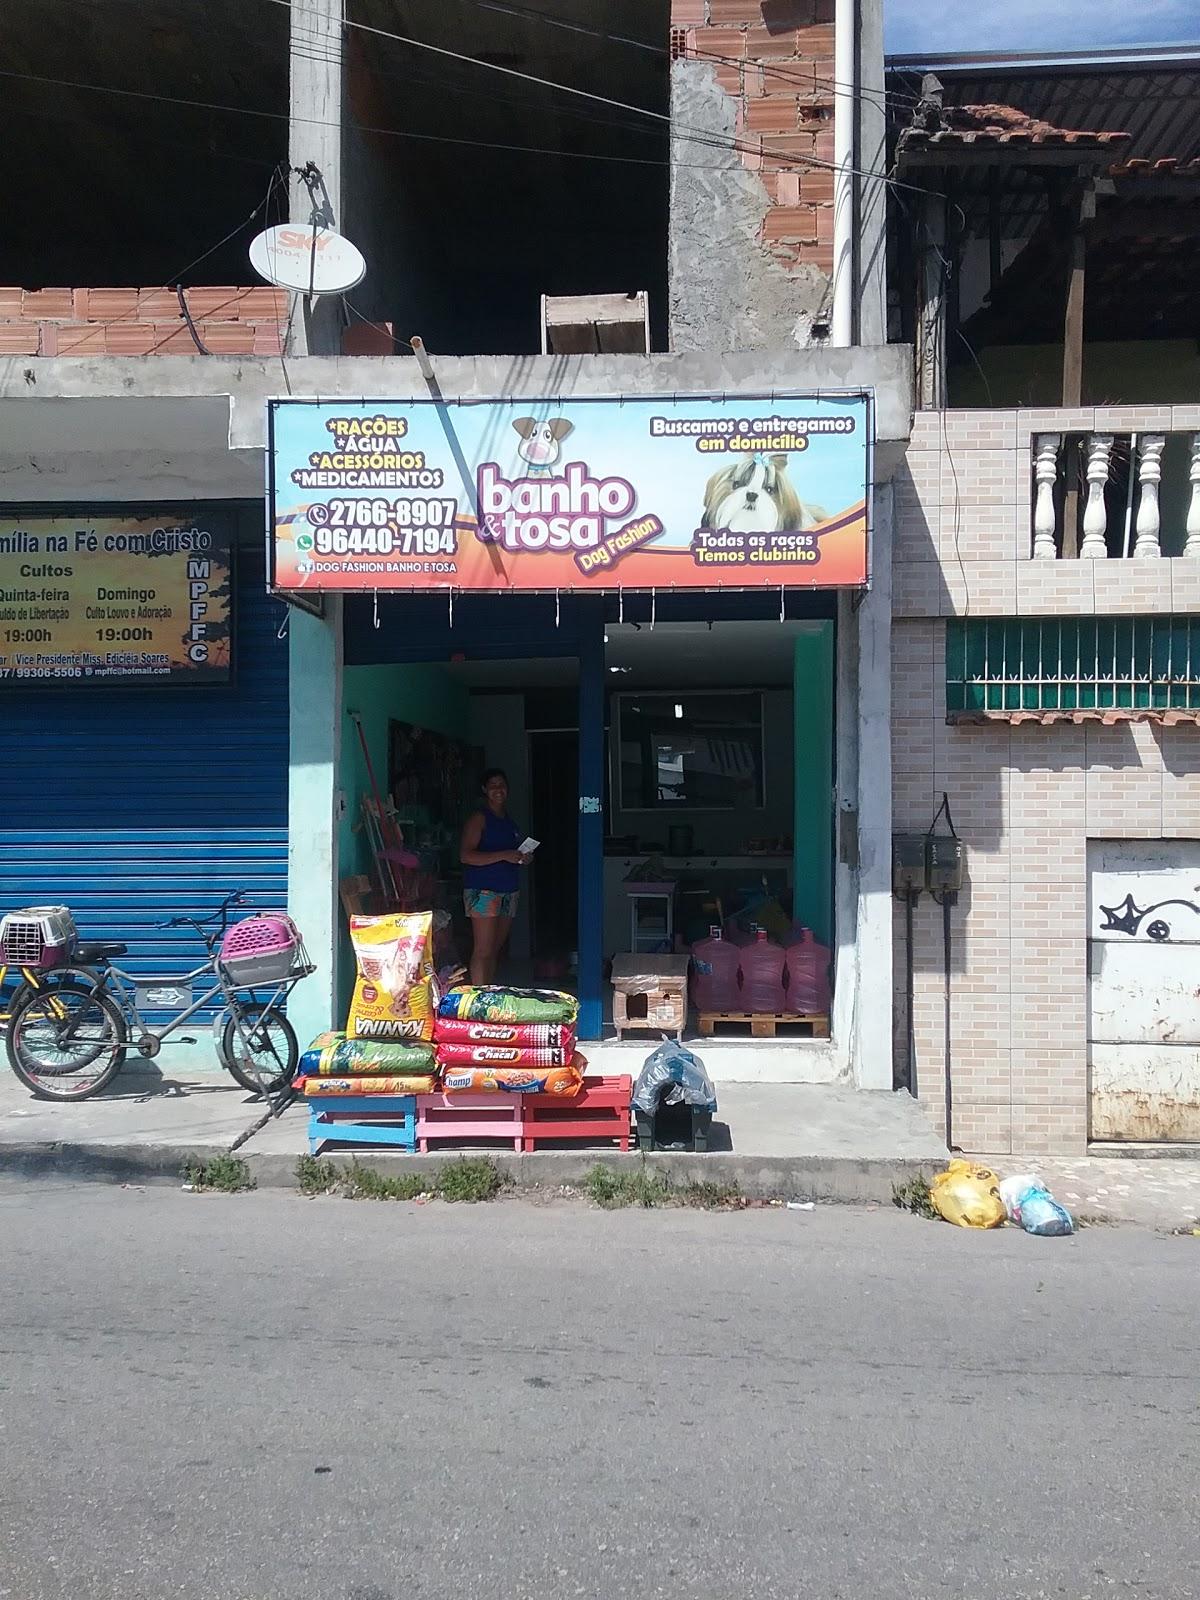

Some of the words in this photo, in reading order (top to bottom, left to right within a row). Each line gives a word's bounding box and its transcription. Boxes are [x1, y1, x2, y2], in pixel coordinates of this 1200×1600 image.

[652, 419, 734, 434] Buscamos
[739, 421, 749, 432] e
[753, 418, 852, 434] entregamos
[699, 438, 724, 450] em
[729, 434, 806, 449] domicílio
[482, 467, 629, 514] banho
[330, 501, 455, 526] 2766-8907
[481, 515, 501, 537] &
[502, 511, 599, 547] tosa
[45, 535, 68, 552] na
[75, 529, 98, 551] Fé
[104, 533, 145, 551] com
[150, 528, 211, 551] Cristo
[316, 528, 455, 553] 96440-7194
[579, 546, 611, 570] Dog
[607, 518, 657, 554] Fashion
[699, 533, 744, 547] Todas
[749, 536, 766, 547] as
[771, 535, 813, 550] raças
[696, 548, 745, 562] Temos
[750, 548, 816, 561] clubinho
[20, 564, 73, 577] Cultos
[316, 562, 340, 573] DOG
[342, 562, 384, 573] FASHION
[386, 562, 422, 573] BANHO
[424, 562, 430, 573] E
[431, 562, 457, 573] TOSA
[97, 588, 156, 603] Domingo
[18, 607, 28, 620] de
[4, 629, 52, 642] 19:00h
[96, 627, 153, 641] 19:00h
[16, 653, 34, 665] Vice
[36, 653, 80, 665] Presidente
[141, 652, 169, 663] Soares
[16, 667, 82, 678] 99306-5506
[355, 1016, 425, 1038] KANINA
[469, 1024, 512, 1039] Chacal
[473, 1047, 515, 1061] Chacal
